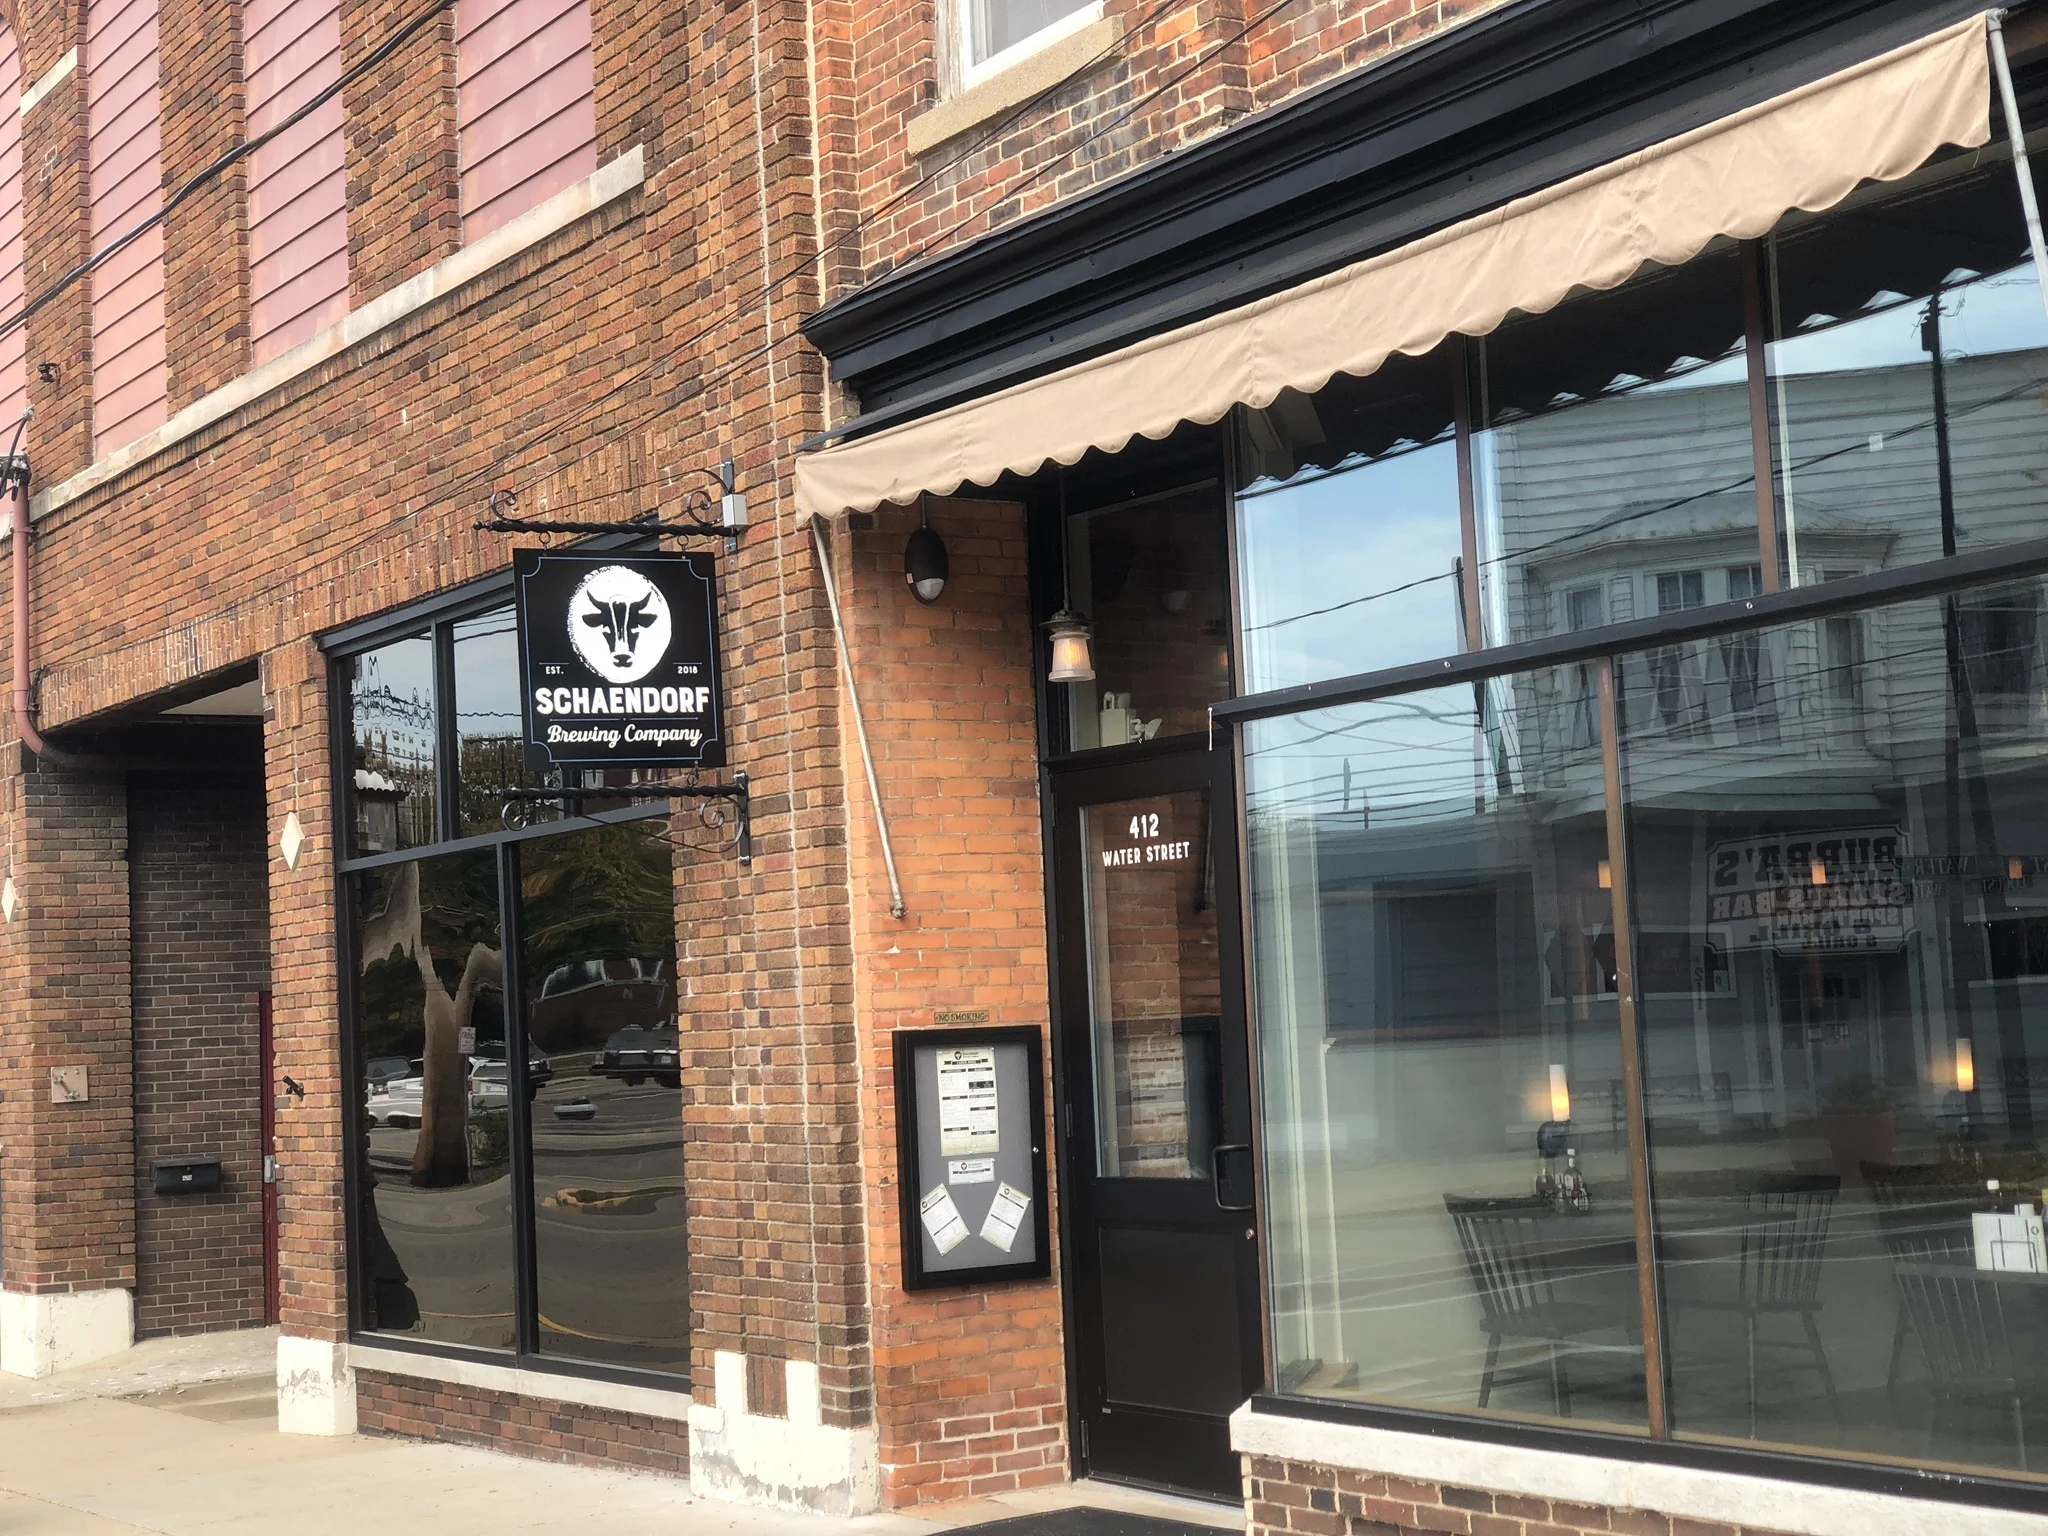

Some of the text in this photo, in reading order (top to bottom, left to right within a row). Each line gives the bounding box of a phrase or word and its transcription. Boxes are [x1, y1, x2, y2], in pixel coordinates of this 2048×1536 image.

[545, 665, 564, 675] EST.
[677, 665, 699, 675] 2018
[535, 686, 710, 715] SCHAENDORF
[547, 723, 703, 748] Brewing Company
[1129, 813, 1160, 839] 412
[1102, 841, 1190, 867] WATER STREET
[937, 1011, 985, 1022] NO SMOKING
